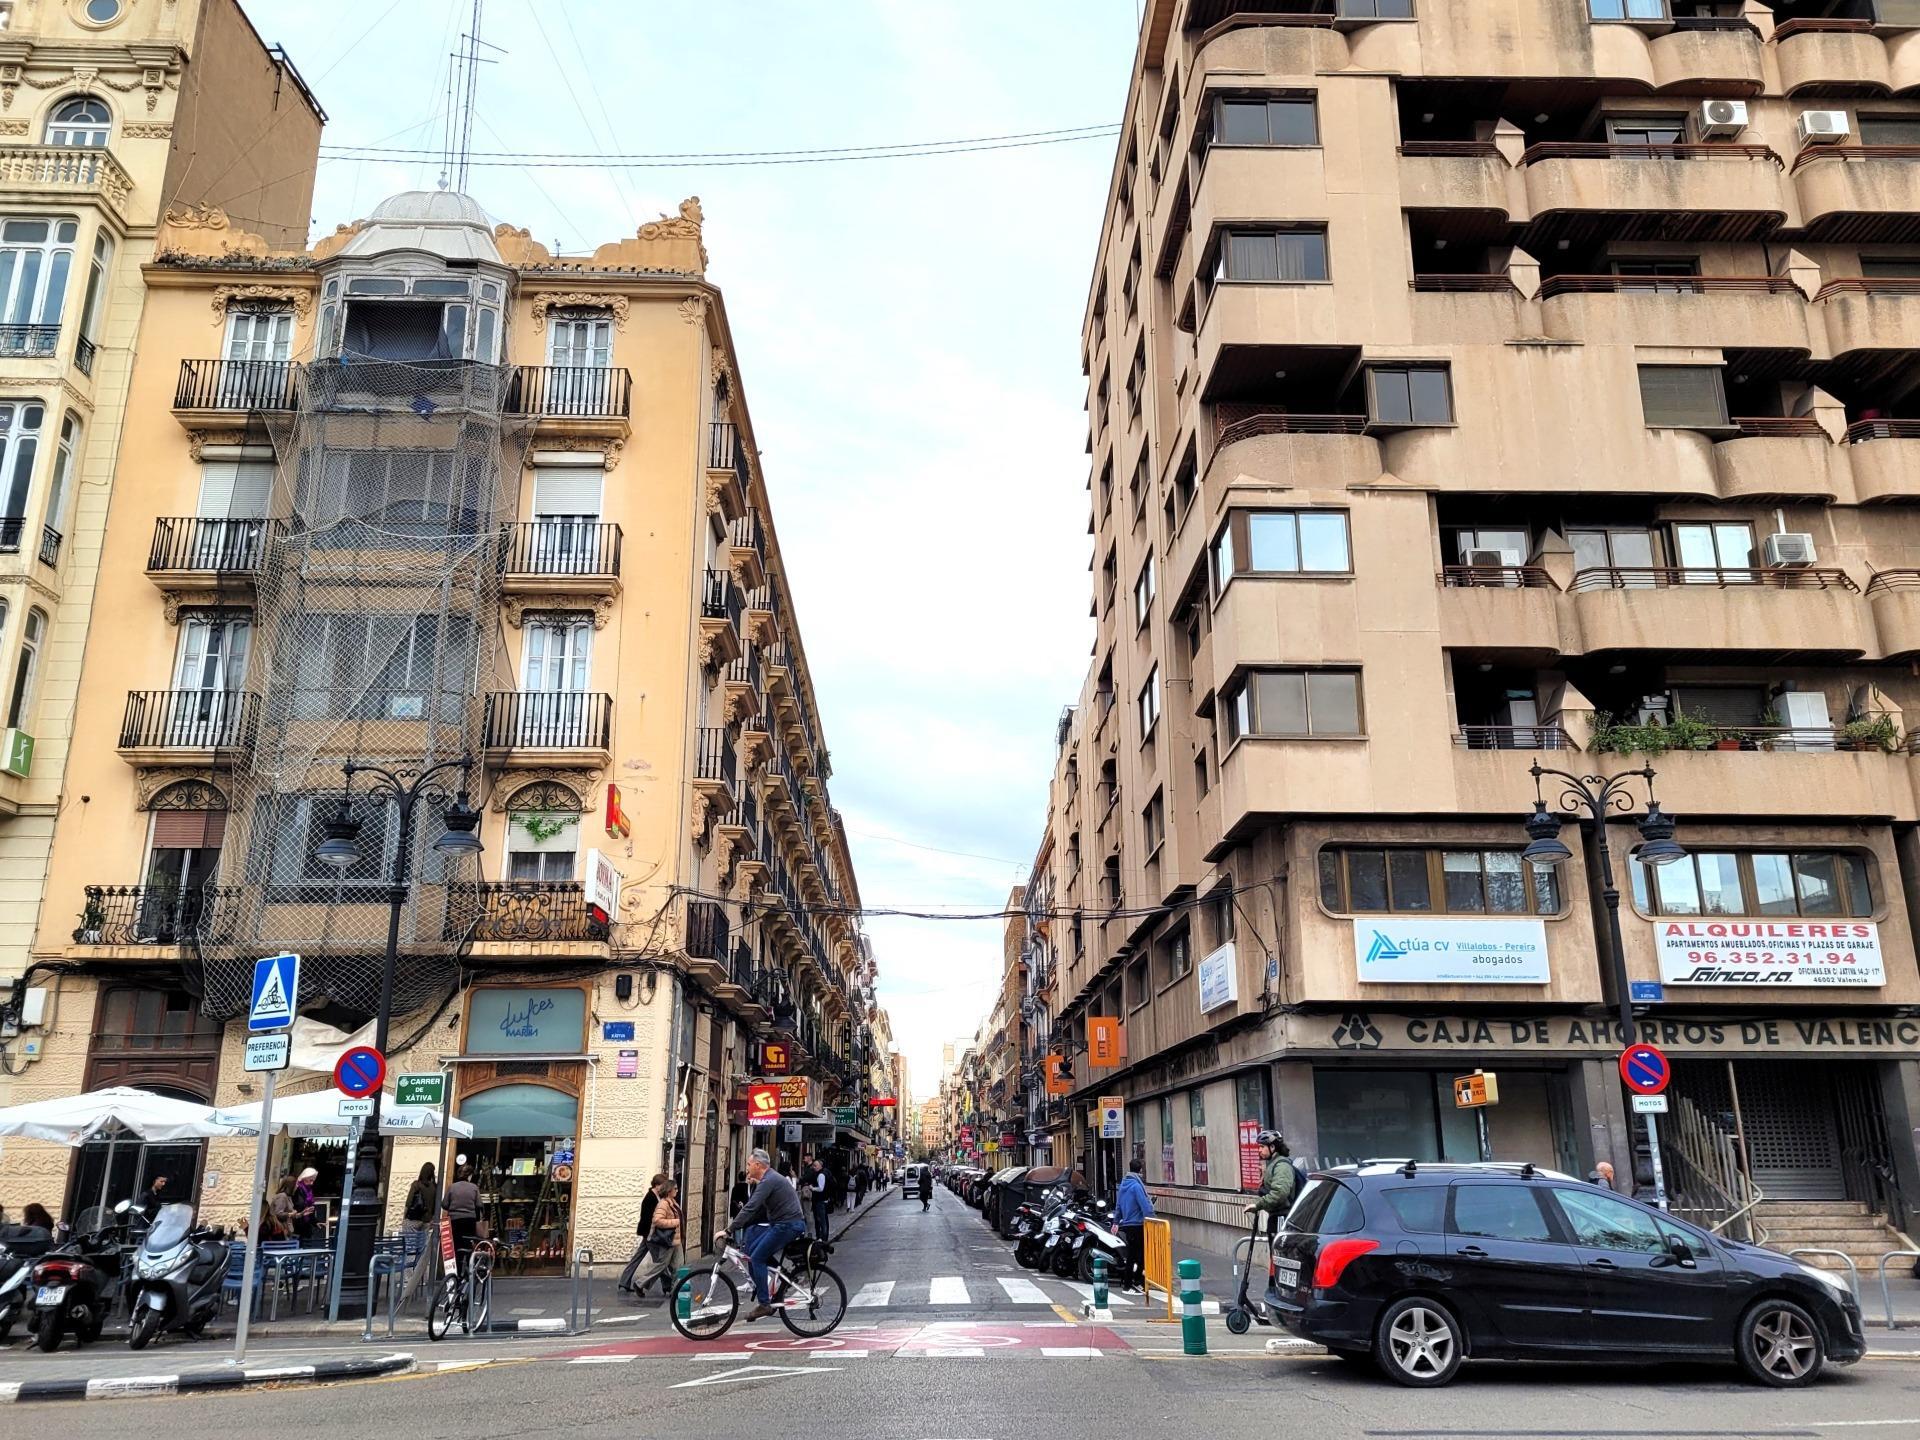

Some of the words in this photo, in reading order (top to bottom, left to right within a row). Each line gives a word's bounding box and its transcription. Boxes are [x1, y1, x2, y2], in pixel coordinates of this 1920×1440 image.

[1665, 924, 1870, 938] ALQUILERES
[1434, 939, 1449, 951] cv
[1456, 942, 1498, 950] Villalobos
[1505, 942, 1536, 951] Pereira
[1666, 940, 1719, 948] APARTAMENTOS
[1801, 941, 1806, 949] Y
[1808, 941, 1834, 949] PLAZAS
[1836, 941, 1846, 949] DE
[1847, 941, 1874, 949] GARAJE
[1472, 954, 1523, 965] abogados
[1687, 951, 1857, 964] 96.352.31.94
[1406, 1019, 1495, 1044] CAJA
[1510, 1021, 1549, 1044] DE
[1567, 1020, 1725, 1044] AHORROS
[1741, 1021, 1780, 1045] DE
[248, 1041, 286, 1051] PREFERENCIA
[252, 1054, 278, 1064] CICLISTA
